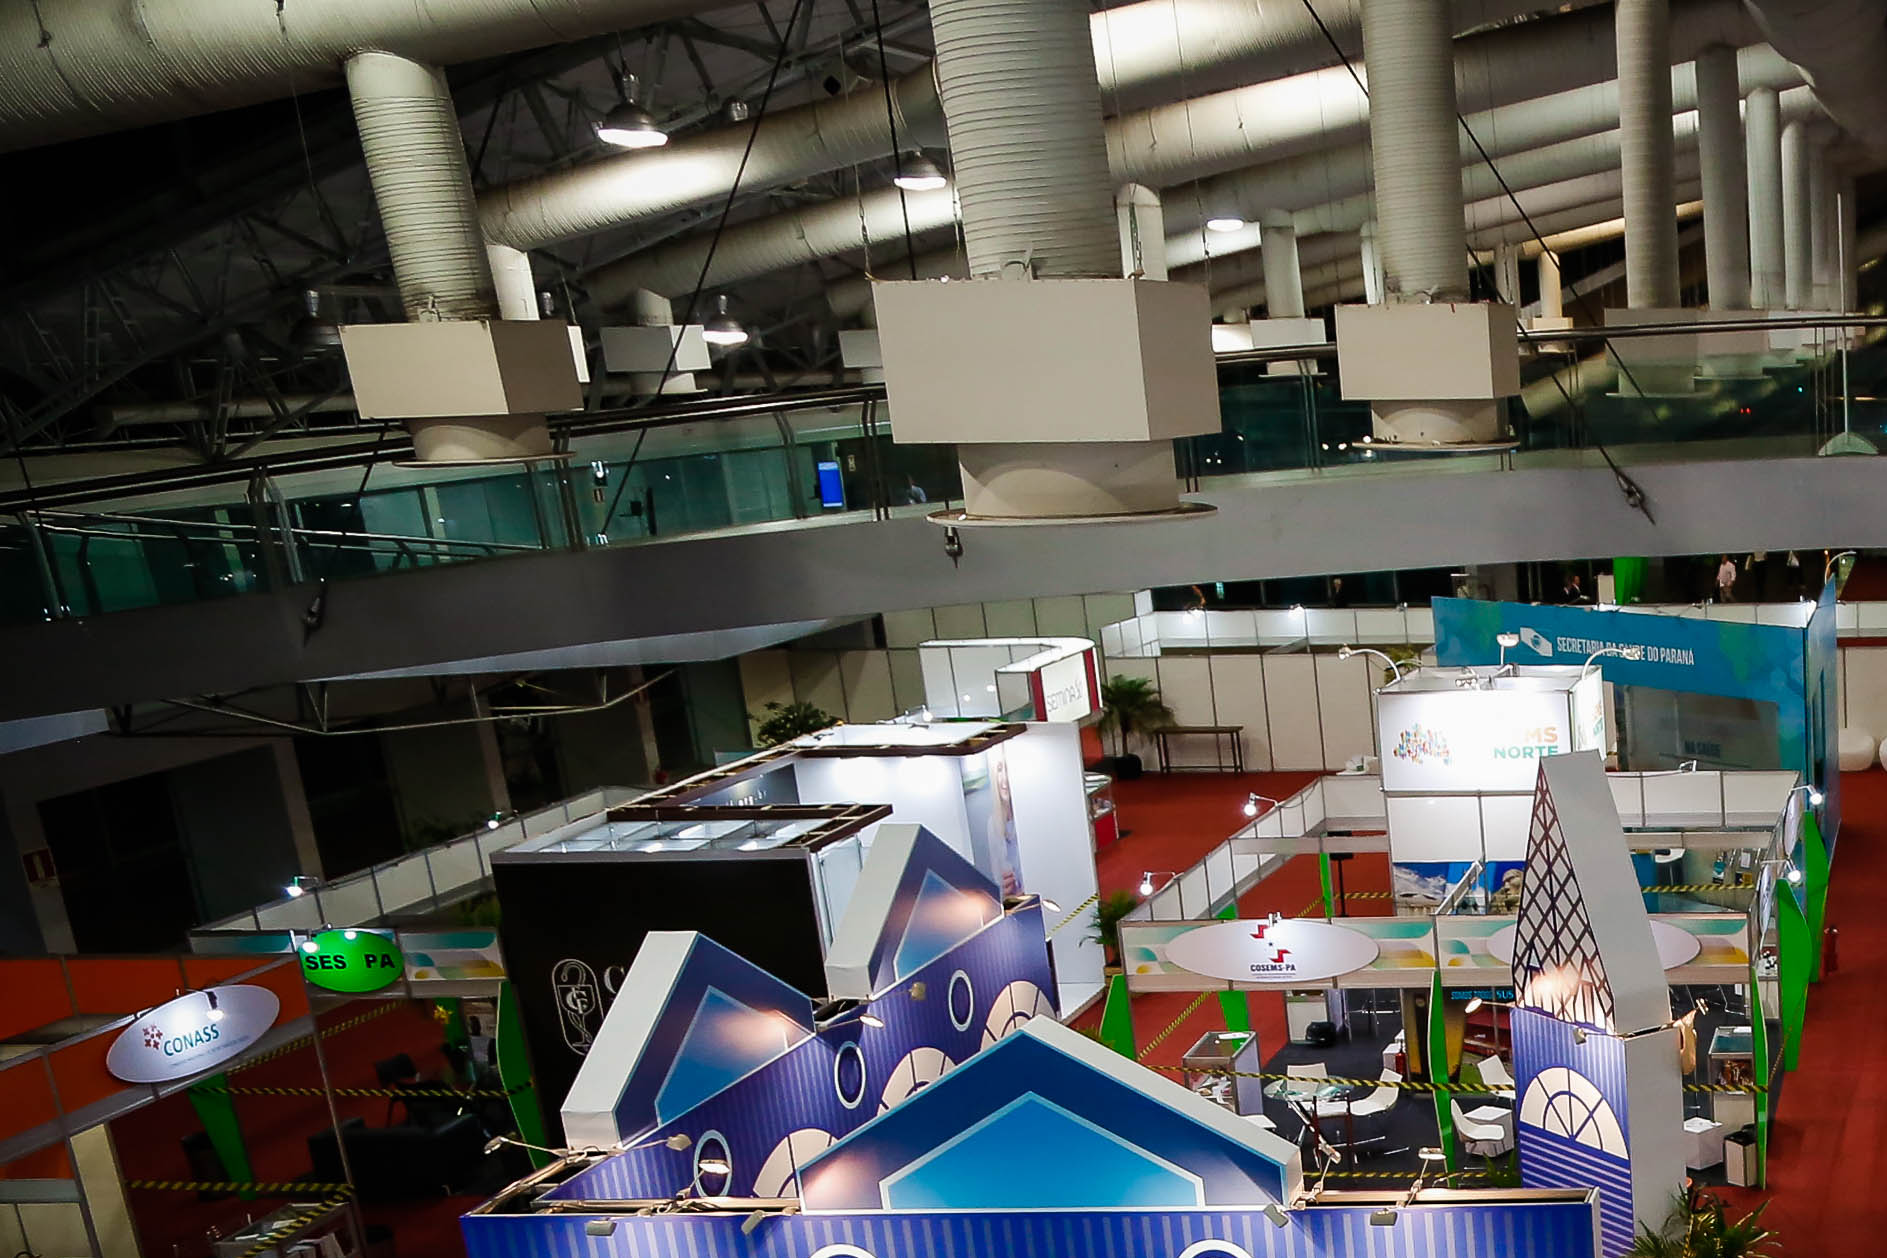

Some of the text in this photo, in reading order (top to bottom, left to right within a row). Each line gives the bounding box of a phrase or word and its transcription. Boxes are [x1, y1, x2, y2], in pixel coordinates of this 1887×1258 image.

[1646, 646, 1659, 662] DO
[1660, 647, 1695, 666] PARANÁ
[1493, 744, 1559, 760] NORTE
[305, 953, 396, 970] SES PA
[1250, 964, 1296, 972] COSEMS-PA
[163, 1023, 220, 1057] CONASS
